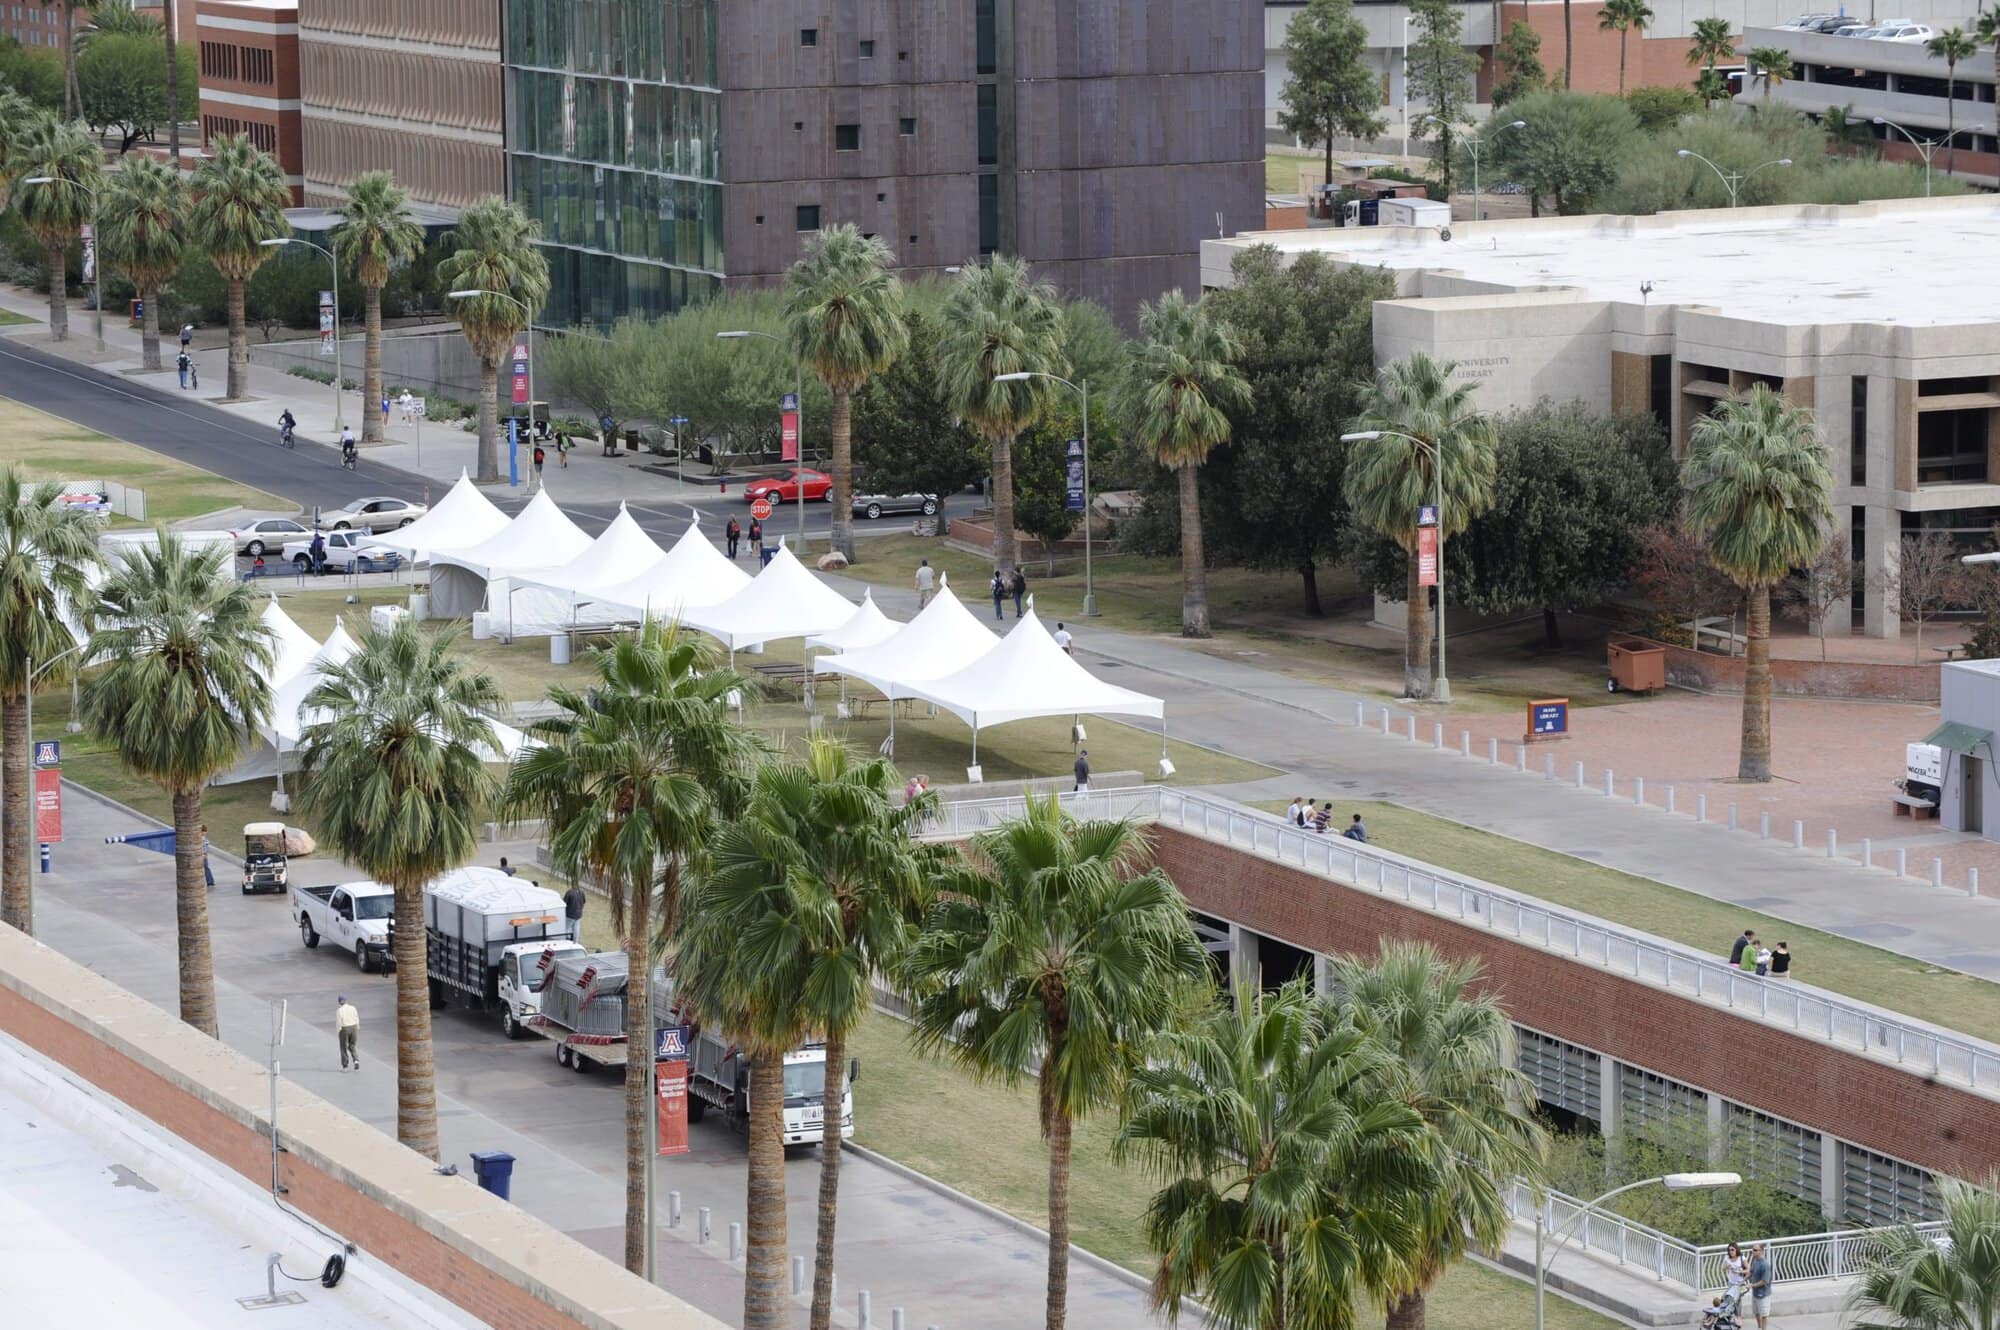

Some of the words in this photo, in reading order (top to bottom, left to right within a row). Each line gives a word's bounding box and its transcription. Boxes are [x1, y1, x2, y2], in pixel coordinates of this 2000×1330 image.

[1458, 356, 1510, 366] UNIVERSITY
[1457, 369, 1494, 378] LIBRARY
[413, 406, 423, 414] 20
[752, 505, 770, 514] STOP
[37, 743, 59, 766] A
[659, 1030, 686, 1056] A
